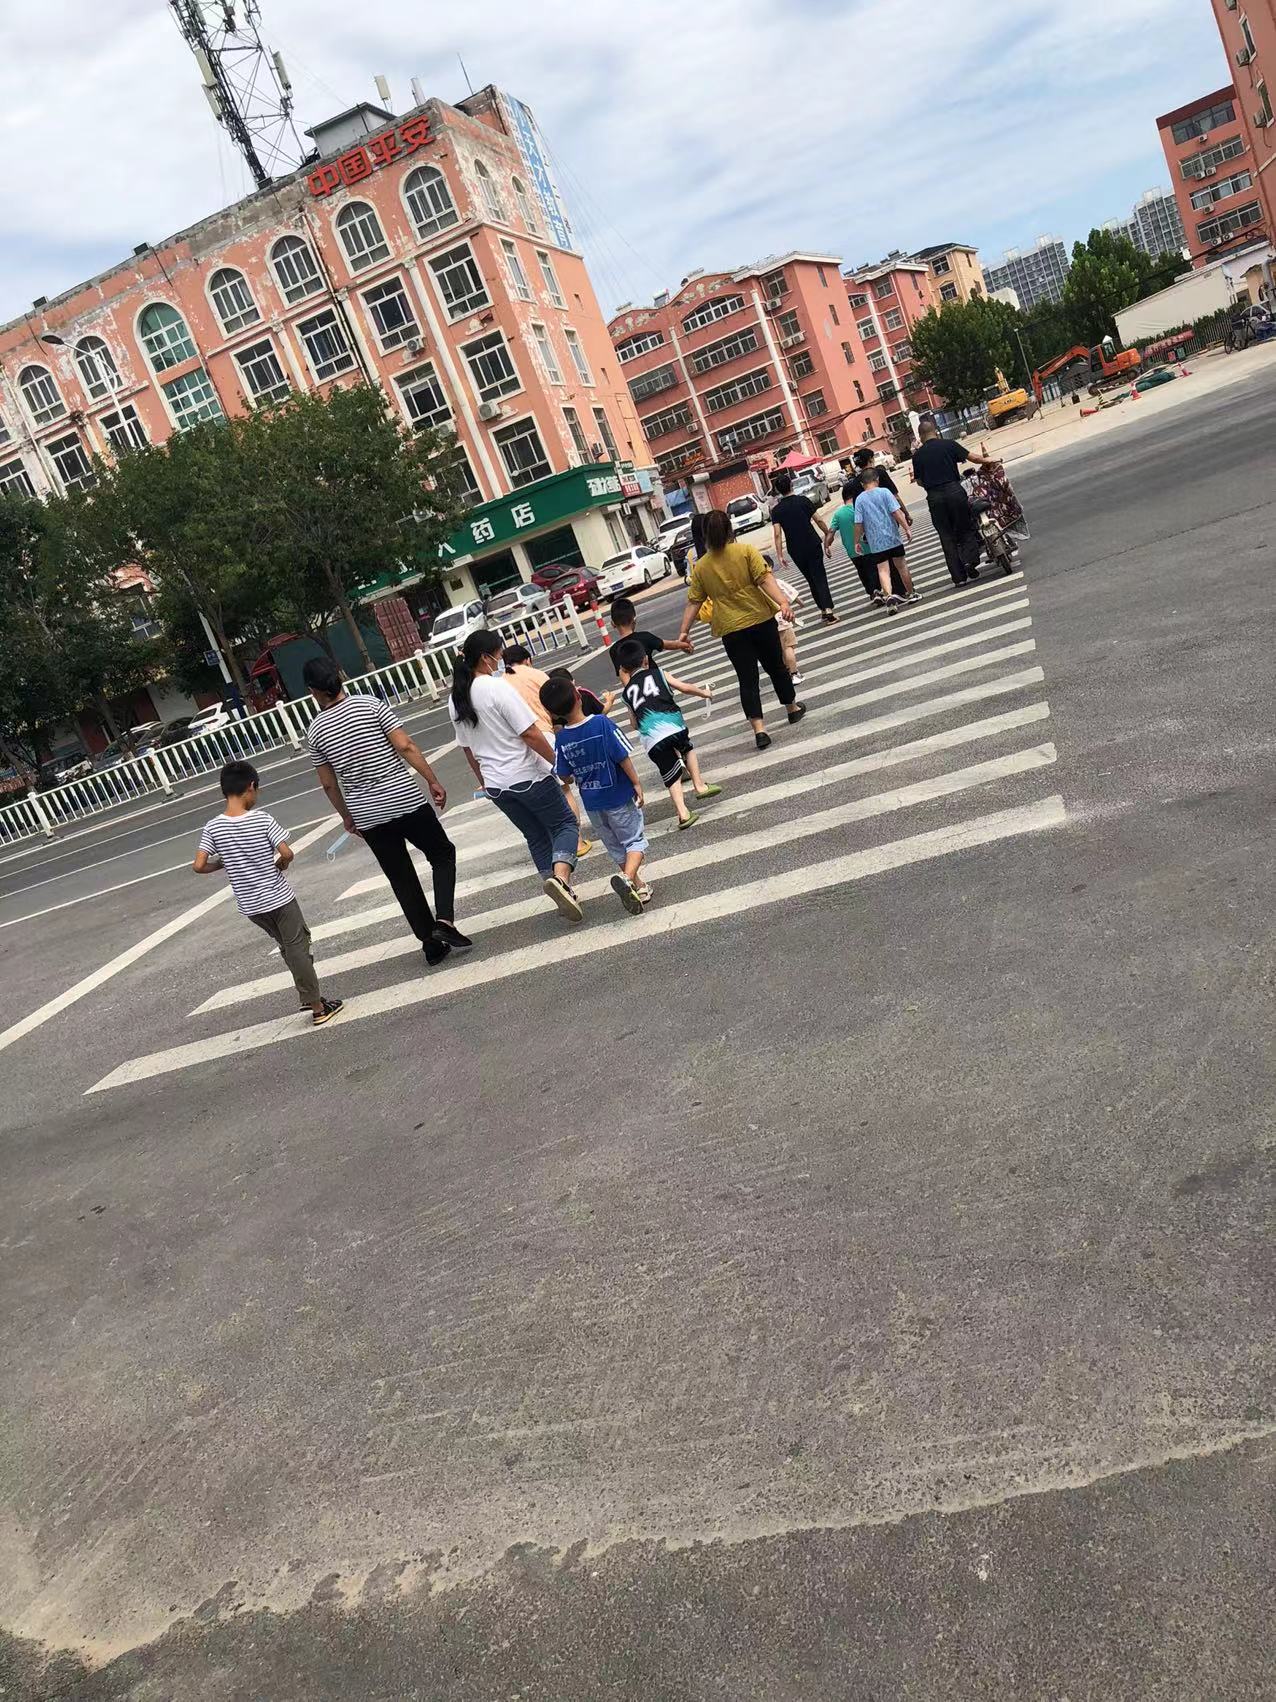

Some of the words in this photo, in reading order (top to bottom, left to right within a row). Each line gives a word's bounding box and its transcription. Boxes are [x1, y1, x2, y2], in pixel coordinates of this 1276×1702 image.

[307, 114, 434, 198] 中国平安
[626, 675, 660, 711] 24
